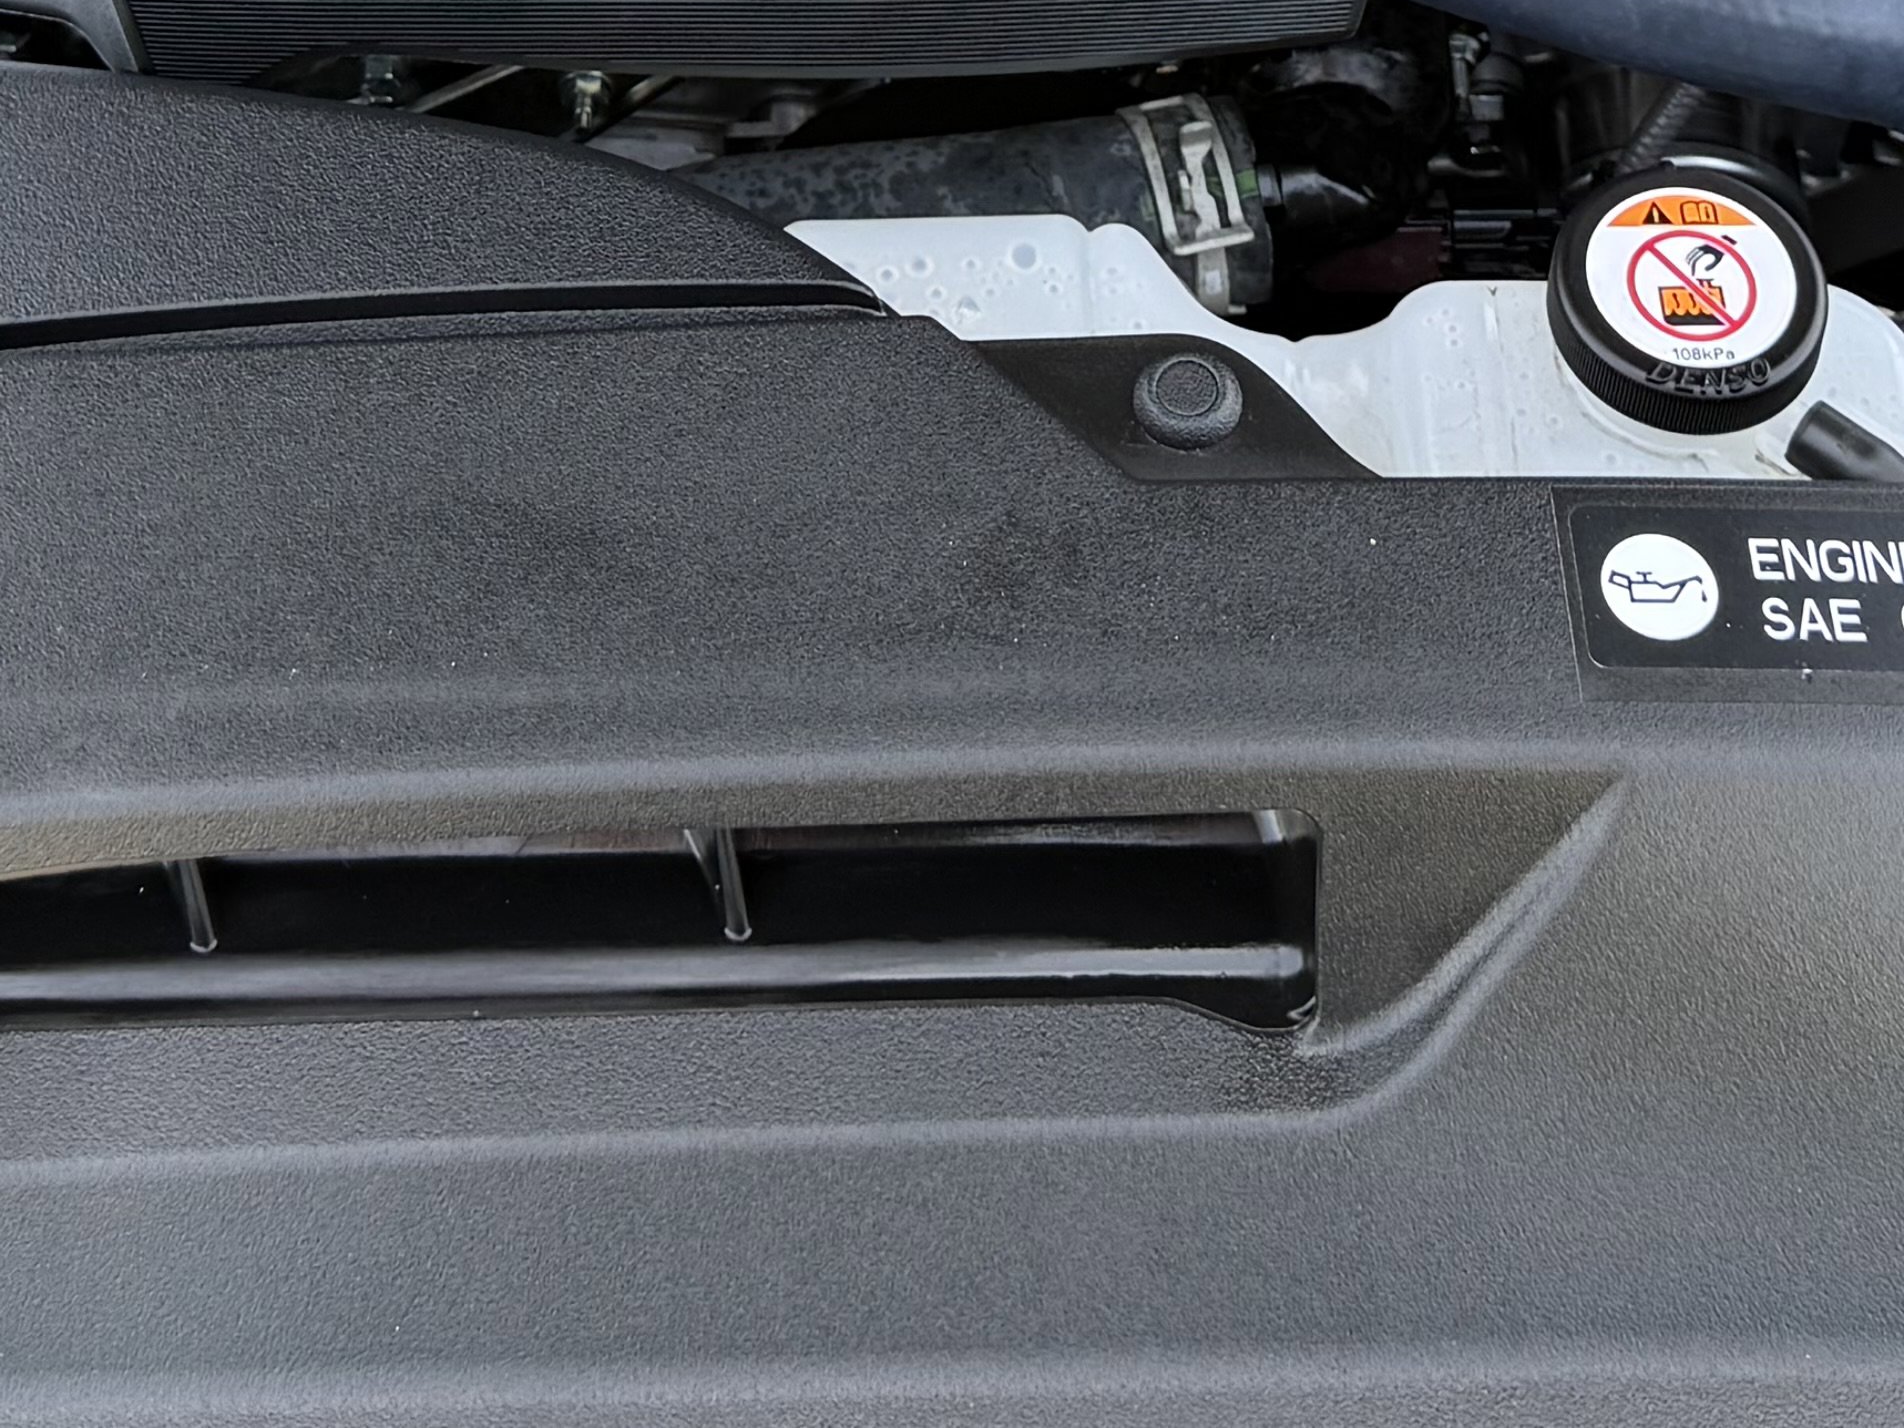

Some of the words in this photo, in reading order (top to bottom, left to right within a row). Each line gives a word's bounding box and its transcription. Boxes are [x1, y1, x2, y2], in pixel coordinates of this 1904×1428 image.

[1672, 346, 1737, 361] 108kPa
[1645, 357, 1772, 394] DENSO
[1761, 596, 1869, 644] SAE
